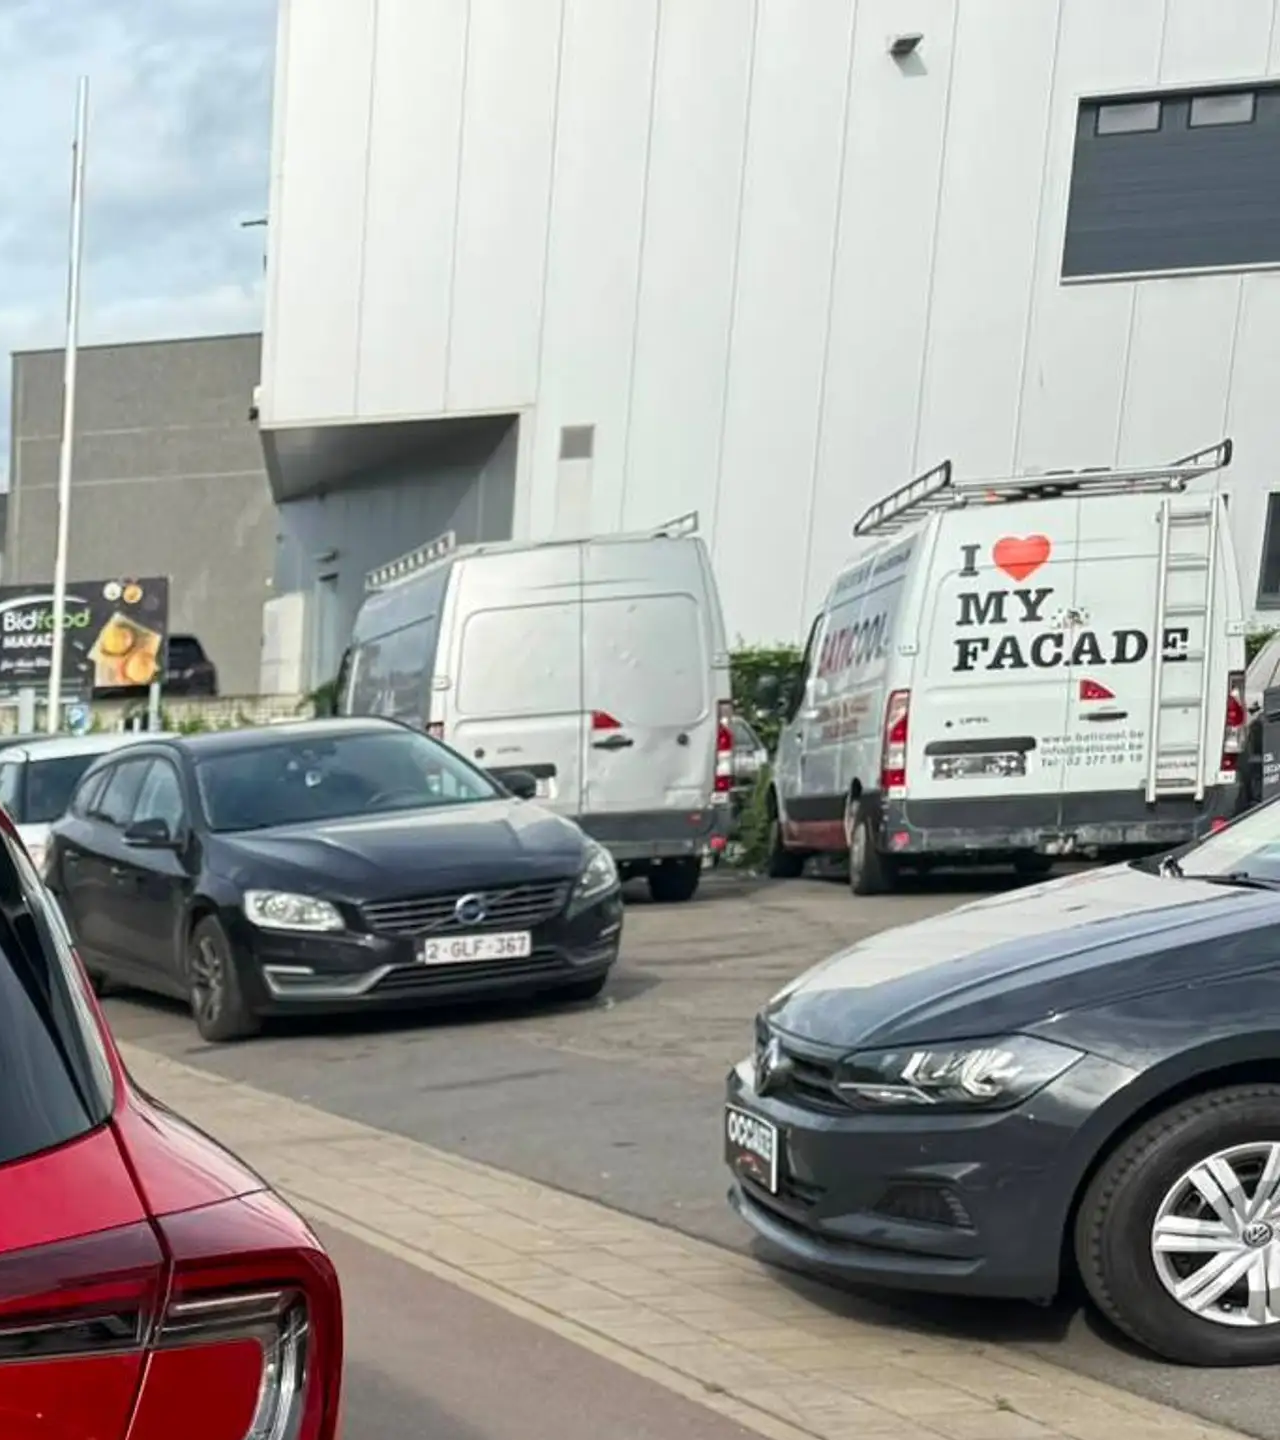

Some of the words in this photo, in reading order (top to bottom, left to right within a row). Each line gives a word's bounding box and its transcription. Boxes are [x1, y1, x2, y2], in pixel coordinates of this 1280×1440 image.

[959, 544, 981, 577] I
[2, 607, 92, 632] Bidfood
[956, 588, 1054, 625] MY
[952, 628, 1189, 671] FACADE
